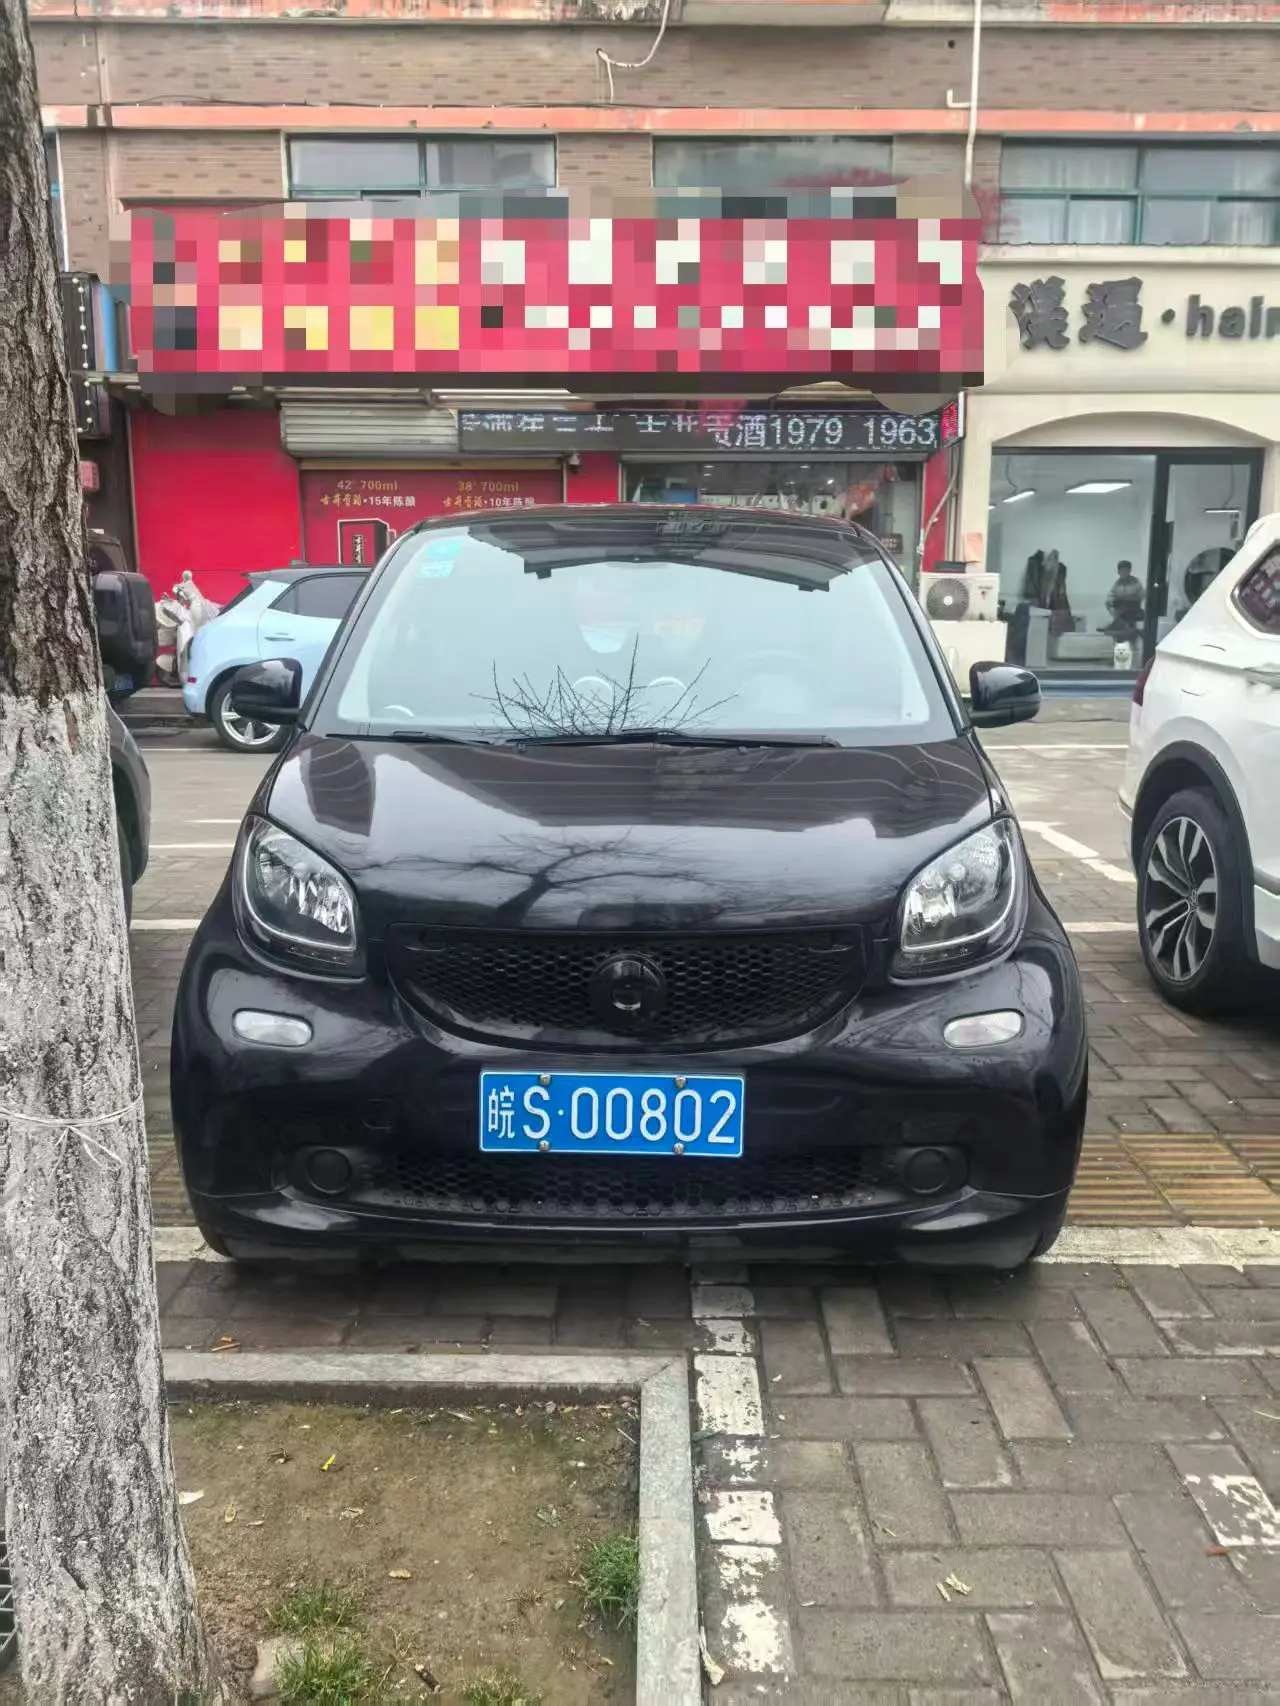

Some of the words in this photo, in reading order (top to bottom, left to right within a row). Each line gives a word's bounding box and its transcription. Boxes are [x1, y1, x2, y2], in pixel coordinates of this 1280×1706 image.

[360, 480, 398, 491] 700ml
[481, 481, 519, 493] 700ml
[487, 1084, 737, 1144] 皖S·00802
